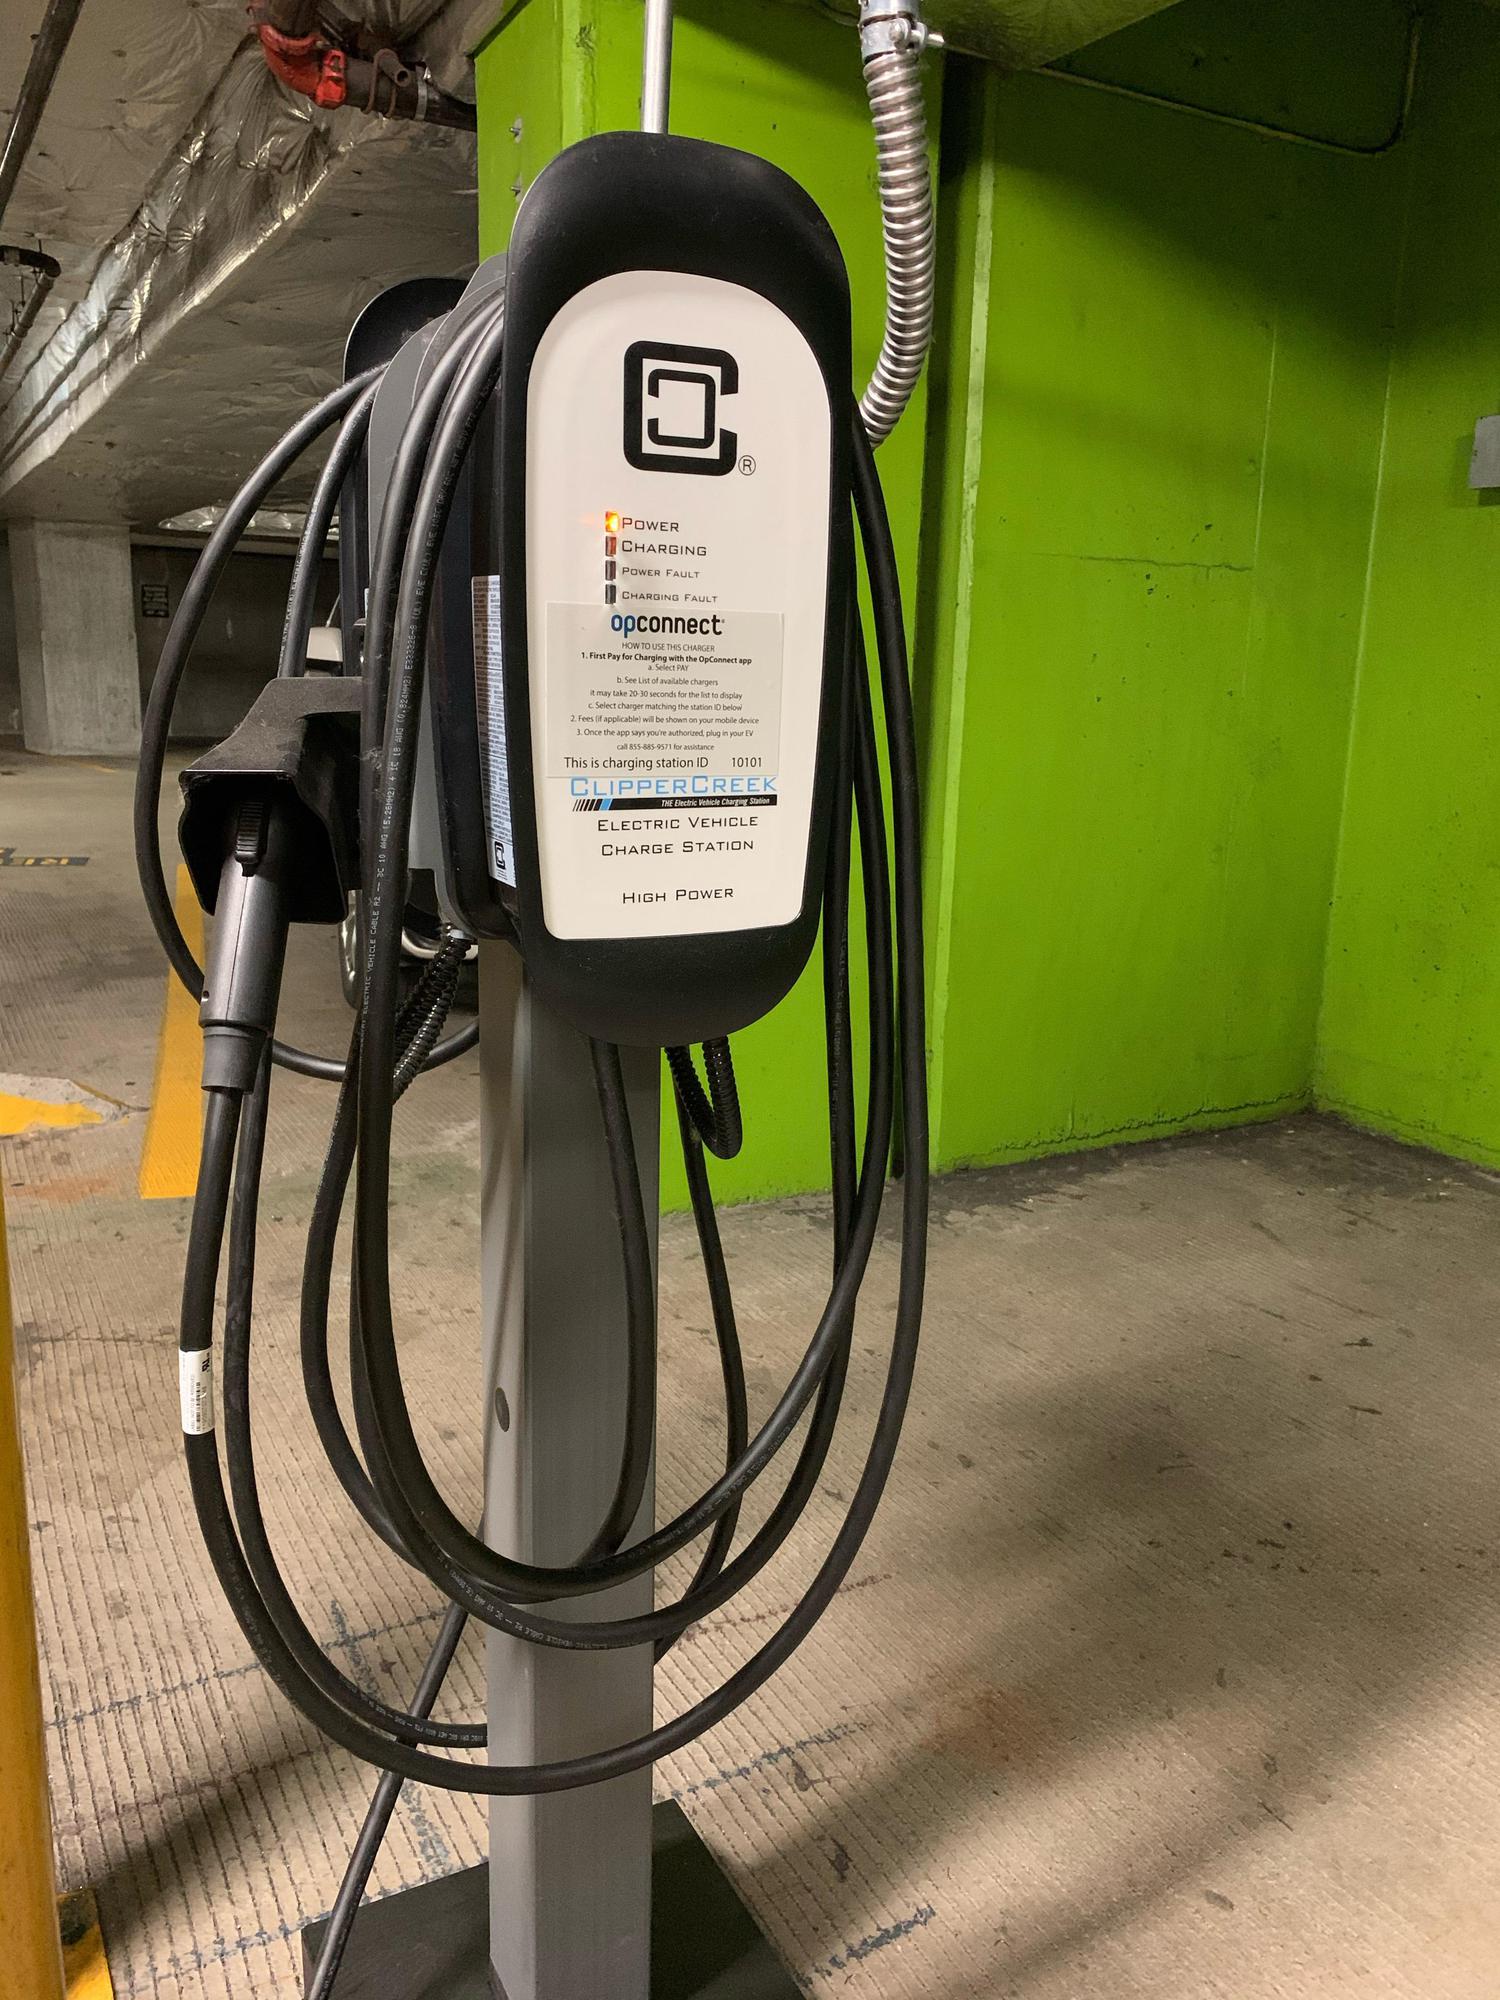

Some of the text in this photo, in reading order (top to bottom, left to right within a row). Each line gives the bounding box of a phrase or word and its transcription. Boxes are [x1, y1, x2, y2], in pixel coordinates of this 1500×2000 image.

[622, 518, 679, 532] POWER
[622, 541, 707, 556] CHARGING
[622, 568, 700, 578] POWER FAULT
[622, 591, 718, 603] CHARGING FAULT
[611, 614, 722, 638] opconnect
[683, 644, 715, 652] CHARGER
[608, 653, 621, 661] Pay
[635, 654, 667, 663] Charging
[699, 656, 737, 664] OpConnect
[690, 679, 718, 687] chargers
[618, 703, 644, 711] charger
[645, 703, 676, 711] matching
[604, 716, 641, 724] applicable)
[706, 730, 720, 738] plug
[564, 757, 762, 771] This is charging station ID 10101
[674, 798, 697, 807] Electric
[699, 798, 719, 806] Vehicle
[722, 797, 748, 807] Charging
[750, 797, 770, 805] Station
[598, 816, 759, 831] ELECTRIC VEHICLE
[601, 840, 754, 856] CHARGE STATION
[622, 888, 734, 904] HIGH POWER
